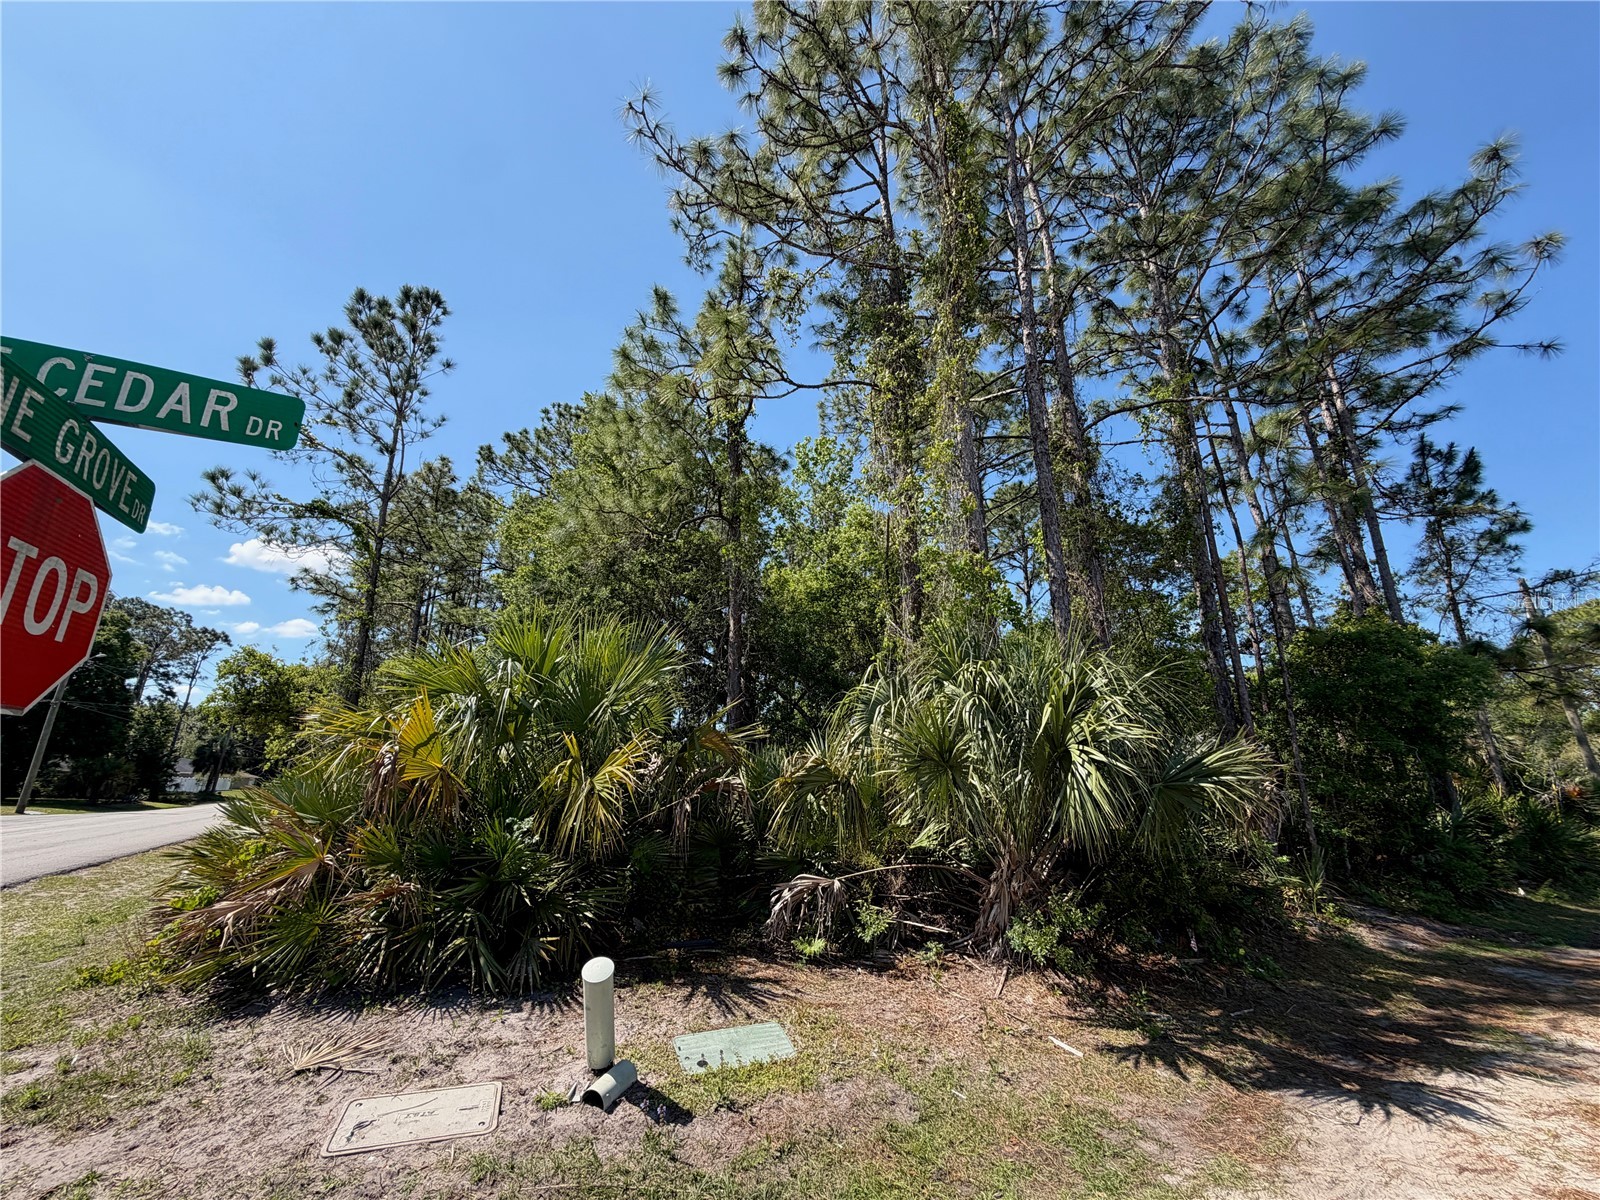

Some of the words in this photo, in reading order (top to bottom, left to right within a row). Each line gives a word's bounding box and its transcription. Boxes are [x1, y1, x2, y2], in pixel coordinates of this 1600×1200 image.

[37, 356, 238, 431] CEDAR
[245, 416, 283, 441] DR
[55, 418, 138, 514] GROVE
[131, 504, 147, 525] DR
